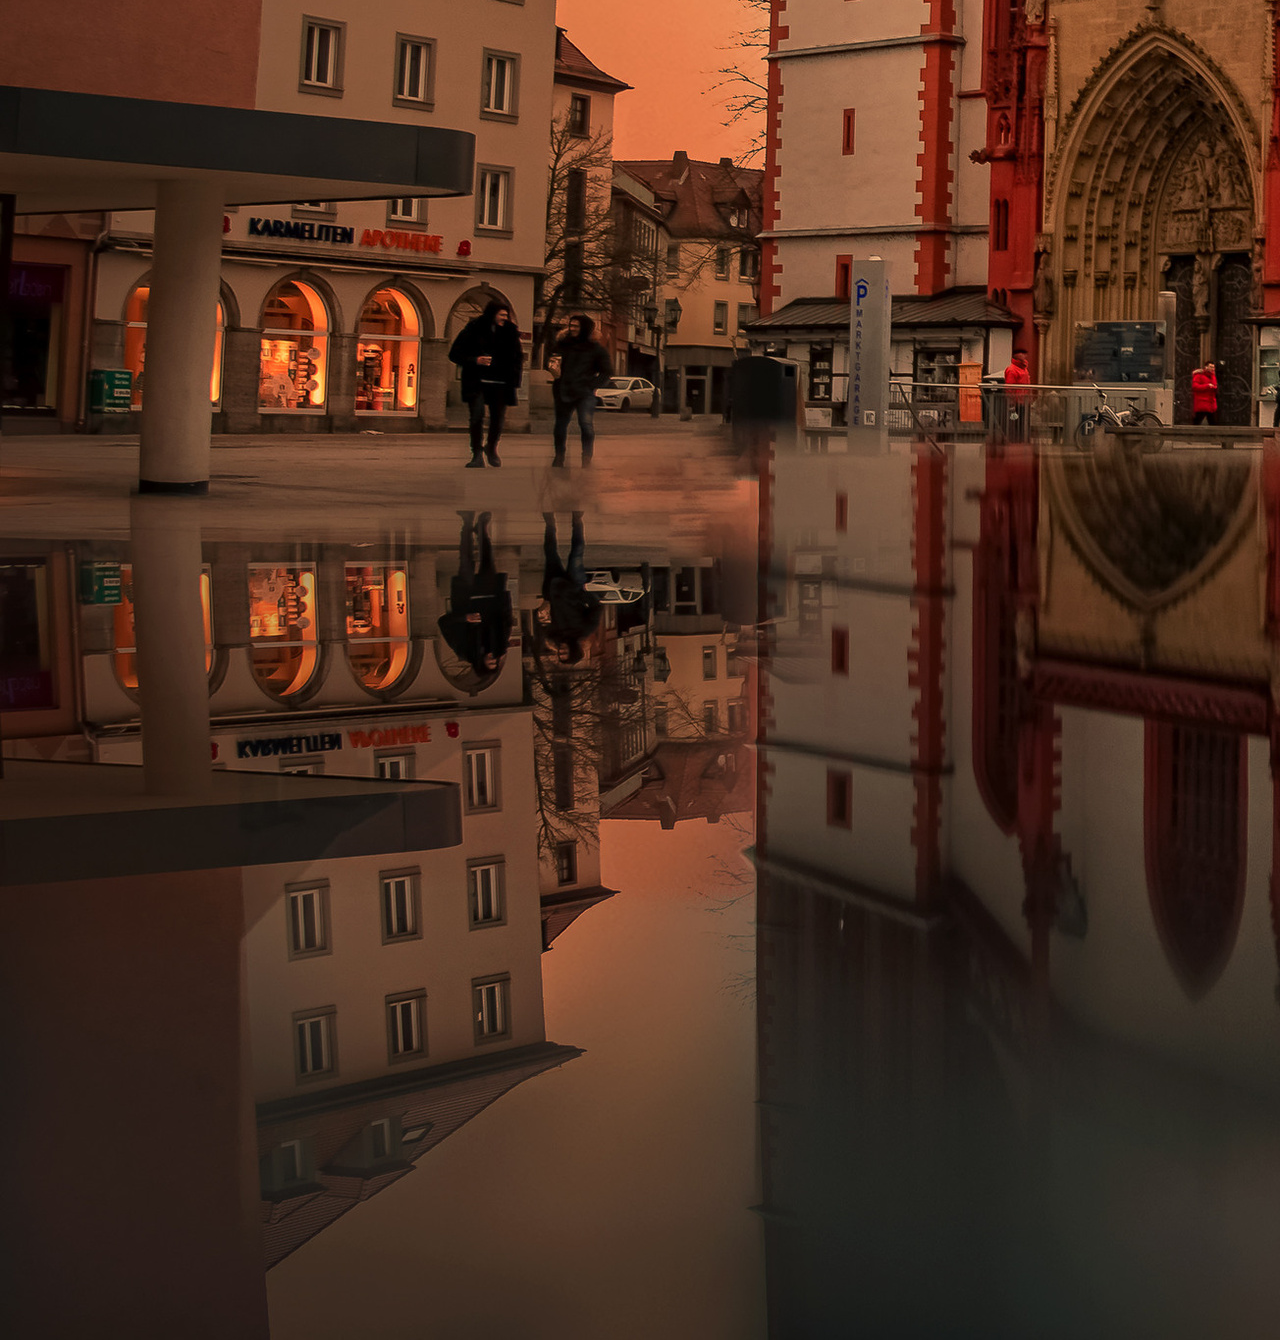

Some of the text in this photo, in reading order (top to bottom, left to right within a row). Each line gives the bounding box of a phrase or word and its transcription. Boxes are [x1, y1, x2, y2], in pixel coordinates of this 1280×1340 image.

[249, 217, 444, 253] KARMELITEN APOTHEKE
[857, 285, 868, 306] P
[854, 309, 863, 425] MARKTGARAGE
